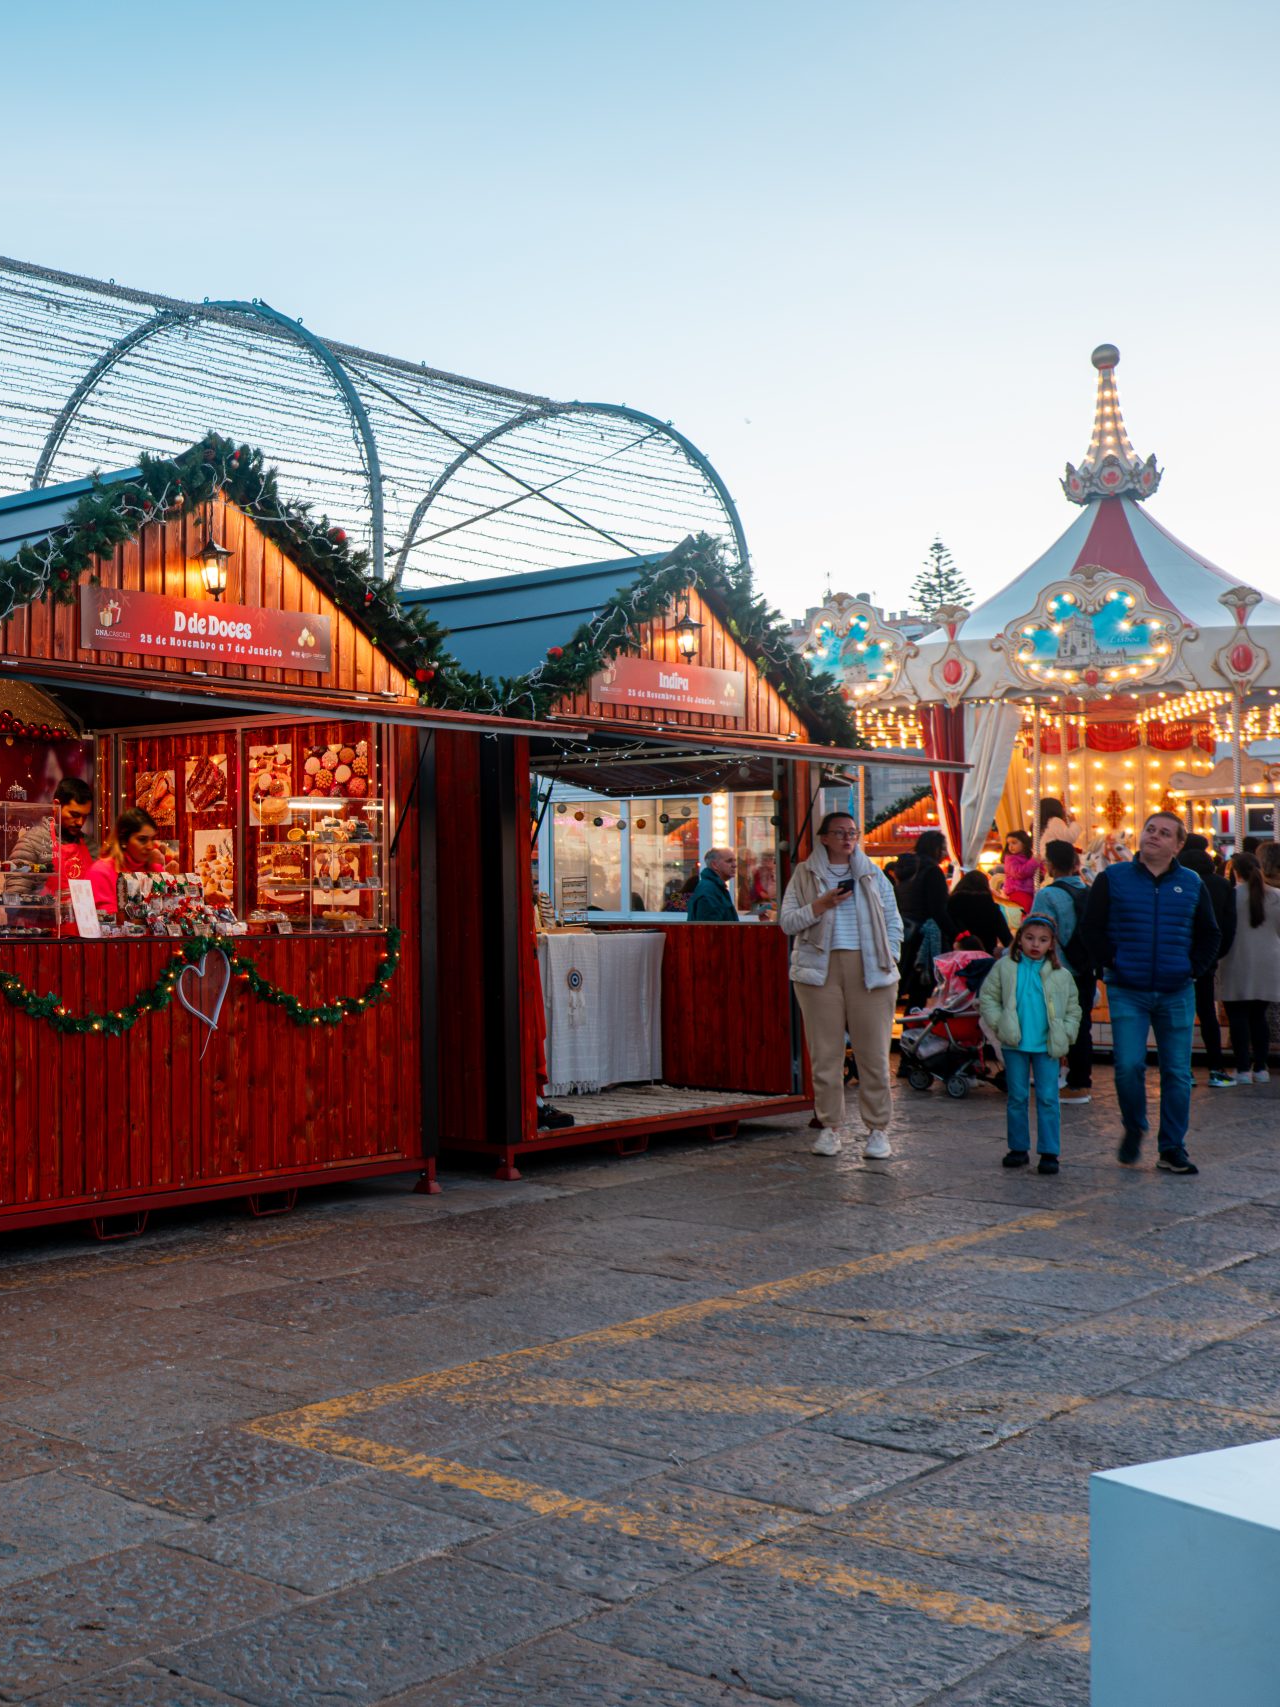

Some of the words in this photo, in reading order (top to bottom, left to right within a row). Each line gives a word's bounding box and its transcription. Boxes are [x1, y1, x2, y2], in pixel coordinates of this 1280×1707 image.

[174, 610, 187, 632] D
[187, 612, 207, 635] de
[209, 615, 252, 640] Doces
[140, 633, 153, 644] 25
[155, 634, 167, 646] de
[169, 636, 216, 651] Novembro
[218, 643, 225, 651] a
[227, 642, 233, 653] 7
[235, 643, 246, 654] de
[247, 645, 283, 658] Janeiro
